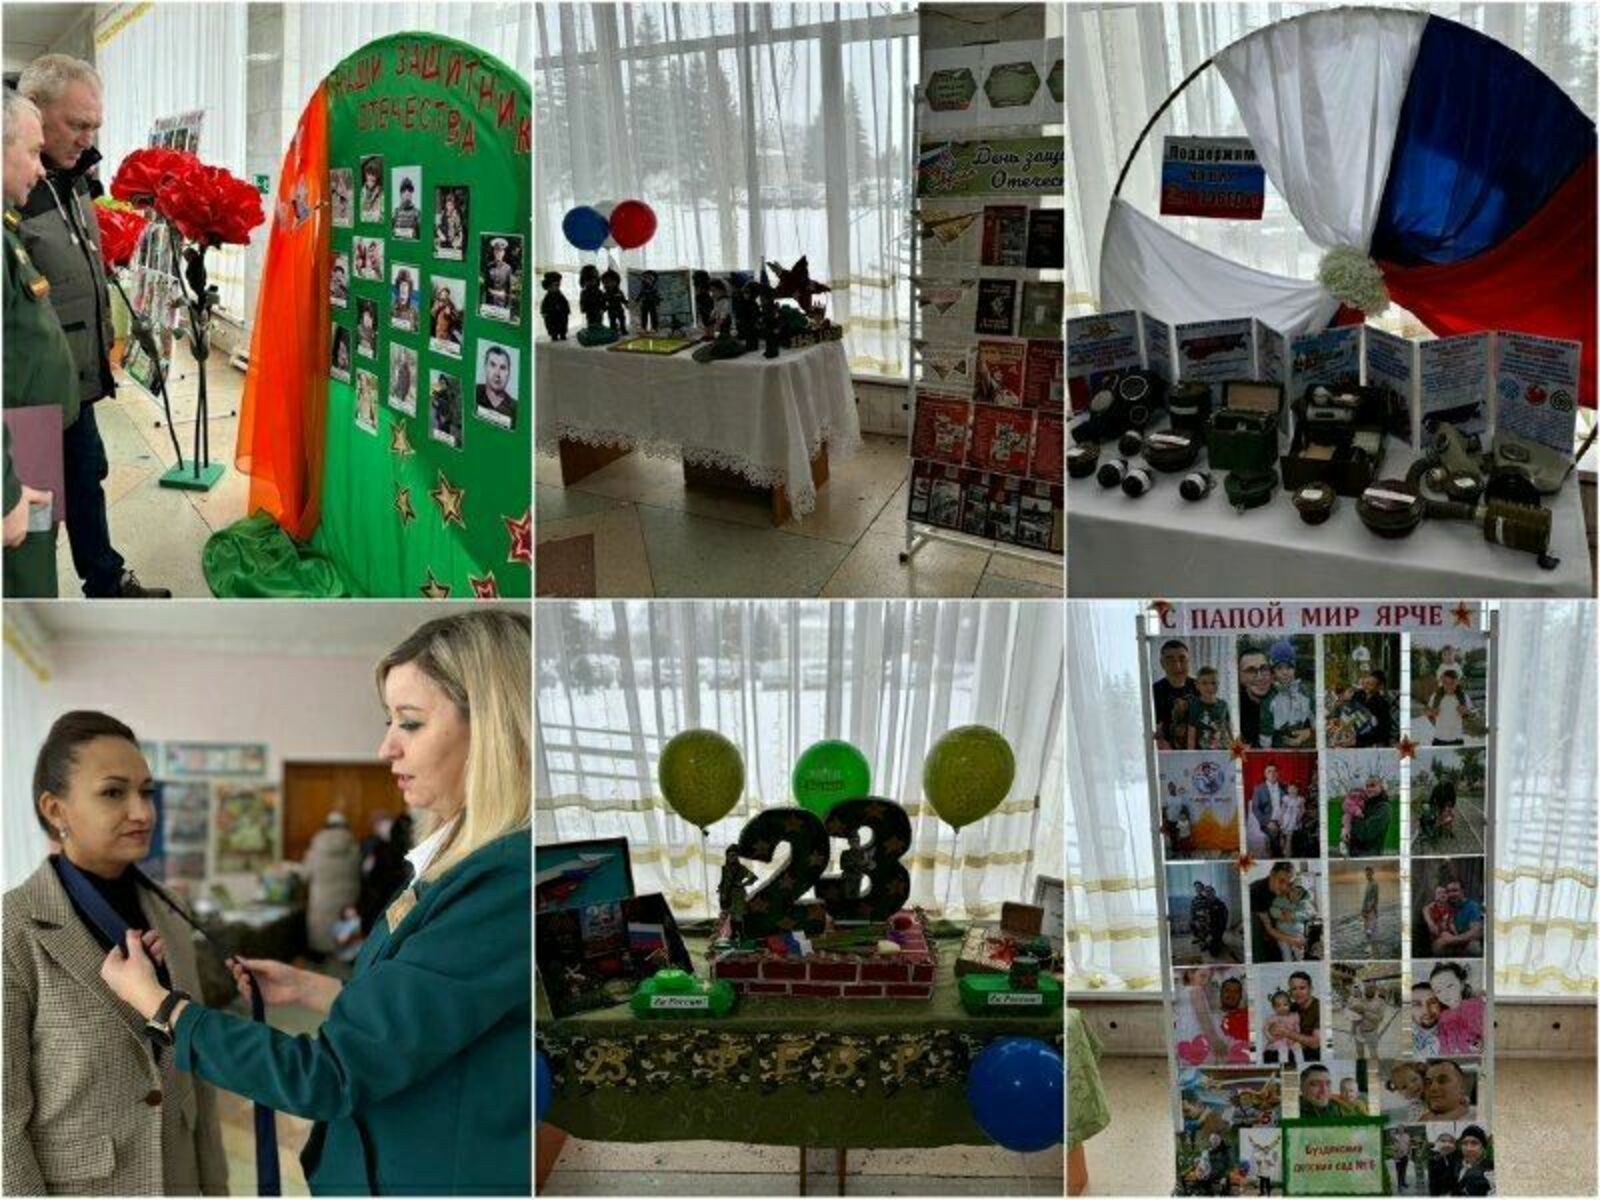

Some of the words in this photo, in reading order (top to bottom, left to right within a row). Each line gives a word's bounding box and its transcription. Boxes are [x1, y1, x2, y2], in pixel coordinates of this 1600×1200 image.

[358, 95, 476, 154] ОТЕЧЕСТВА
[972, 147, 1020, 165] День
[1160, 609, 1177, 629] С
[1191, 601, 1285, 629] ПАПОЙ
[1301, 607, 1360, 628] МИР
[1375, 604, 1443, 627] ЯРЧЕ
